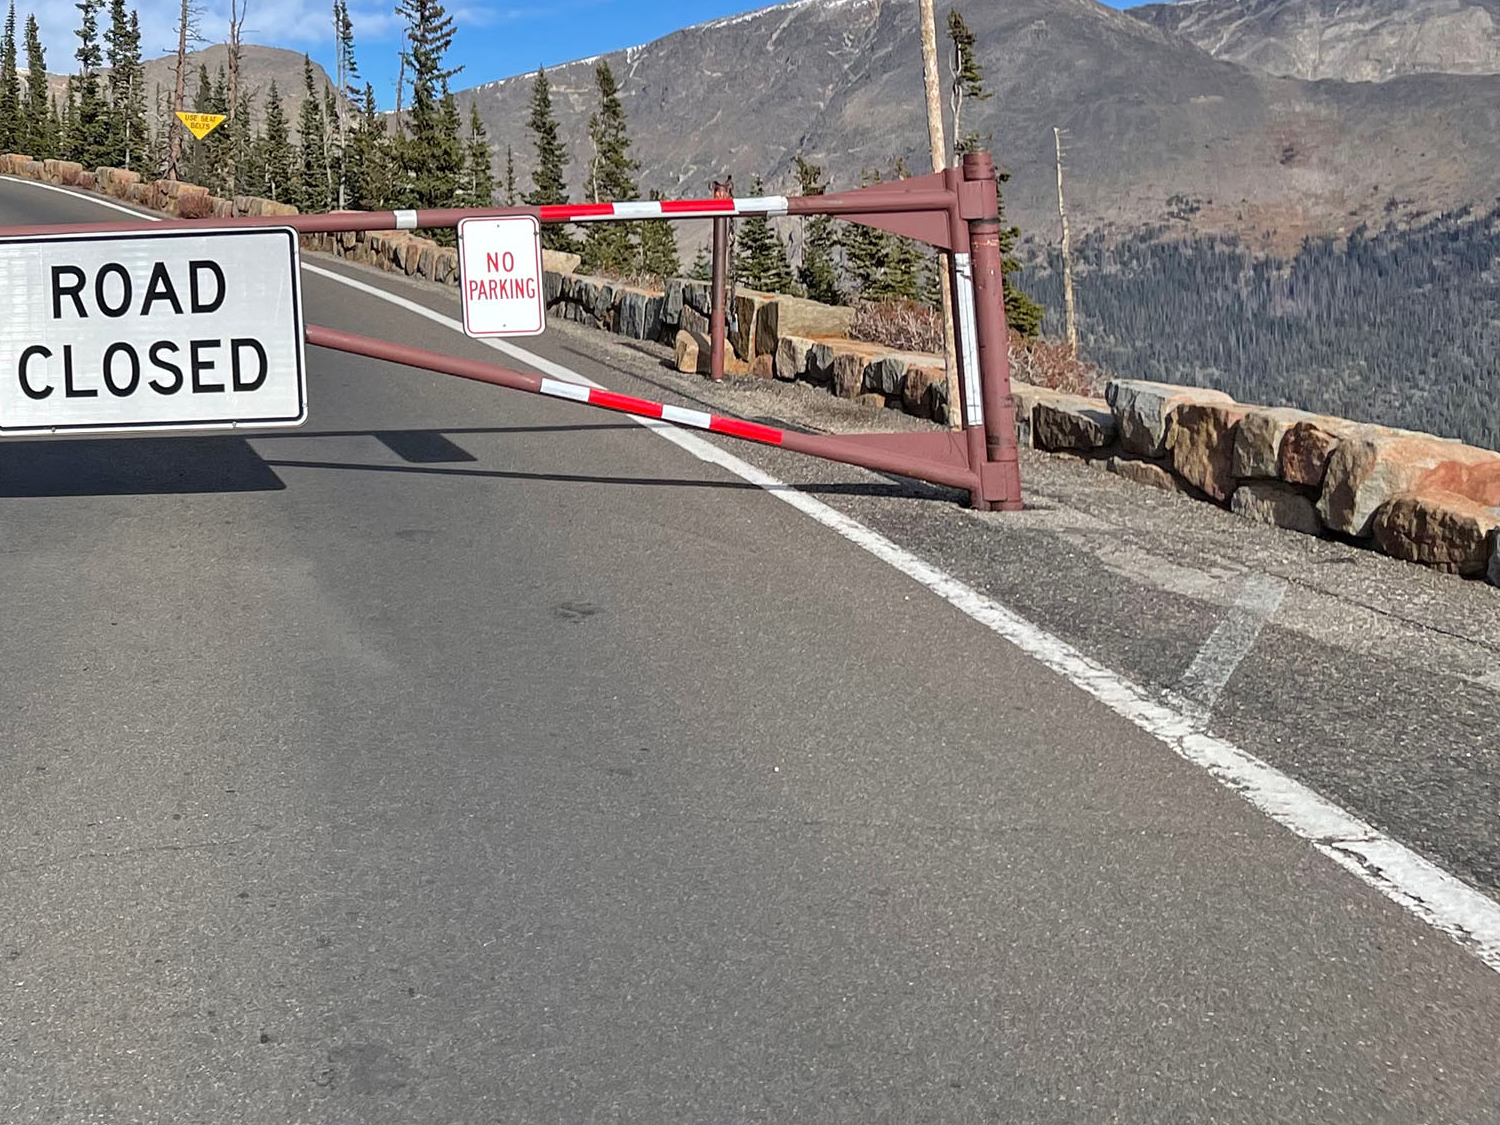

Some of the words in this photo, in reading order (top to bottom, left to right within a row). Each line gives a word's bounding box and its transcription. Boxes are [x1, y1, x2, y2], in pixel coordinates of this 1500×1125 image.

[190, 122, 211, 130] BELTS
[486, 251, 514, 273] NO
[50, 260, 226, 319] ROAD
[469, 277, 536, 300] PARKING
[18, 338, 268, 400] CLOSED
